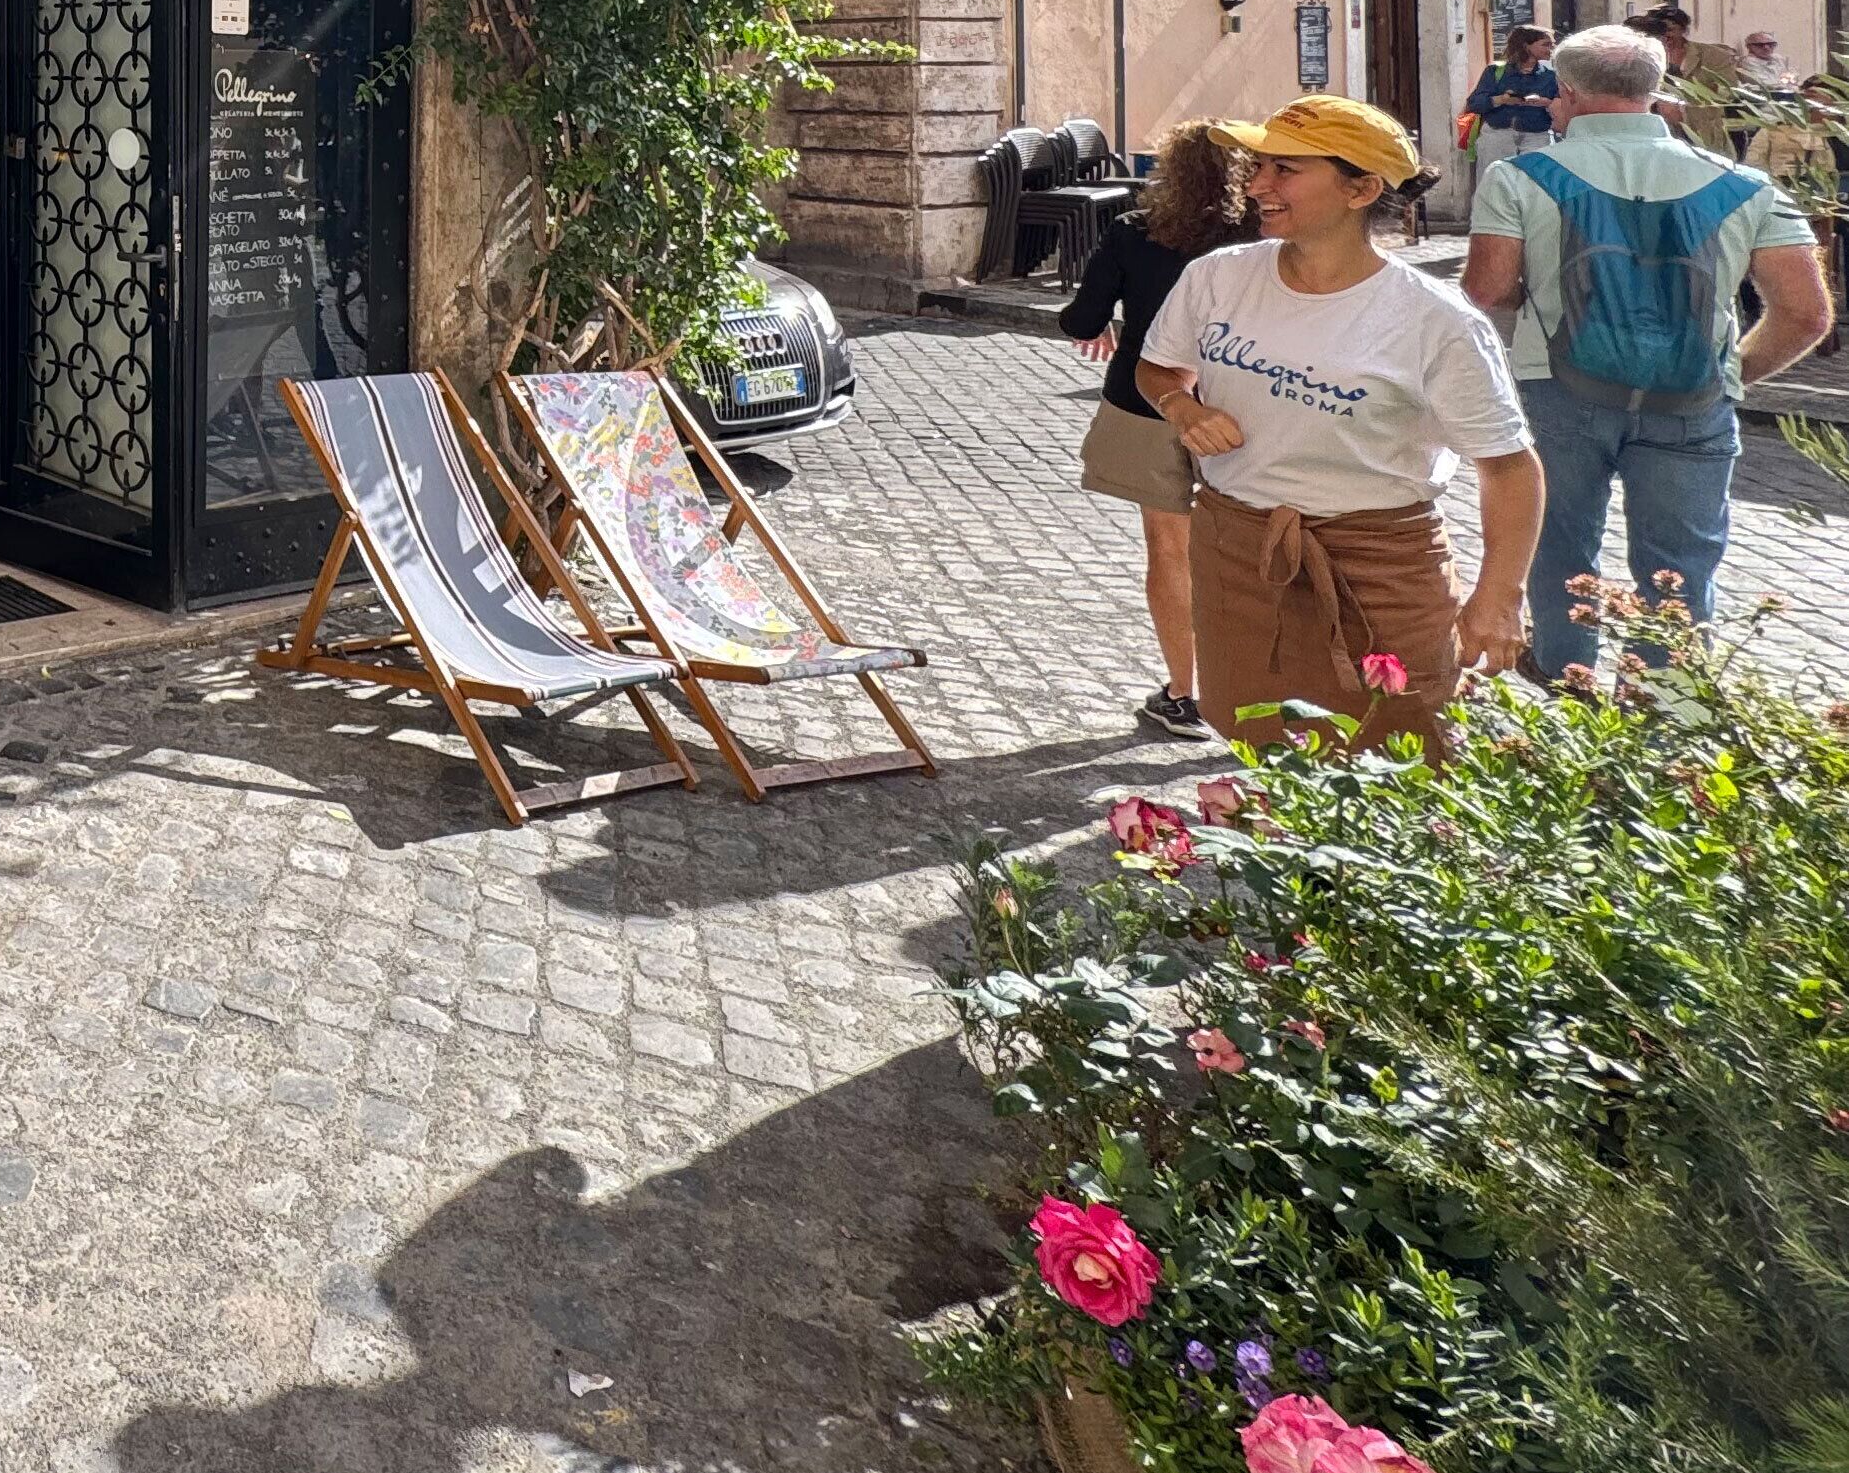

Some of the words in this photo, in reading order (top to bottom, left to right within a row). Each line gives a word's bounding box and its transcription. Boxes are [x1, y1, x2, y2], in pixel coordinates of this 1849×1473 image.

[215, 68, 297, 117] Pellegrino
[210, 127, 233, 139] ONO
[210, 149, 247, 161] PPETTA
[209, 211, 257, 225] SCHETTA
[208, 278, 243, 293] ANNA
[1198, 322, 1369, 402] Pellegrino
[1284, 388, 1354, 418] ROMA
